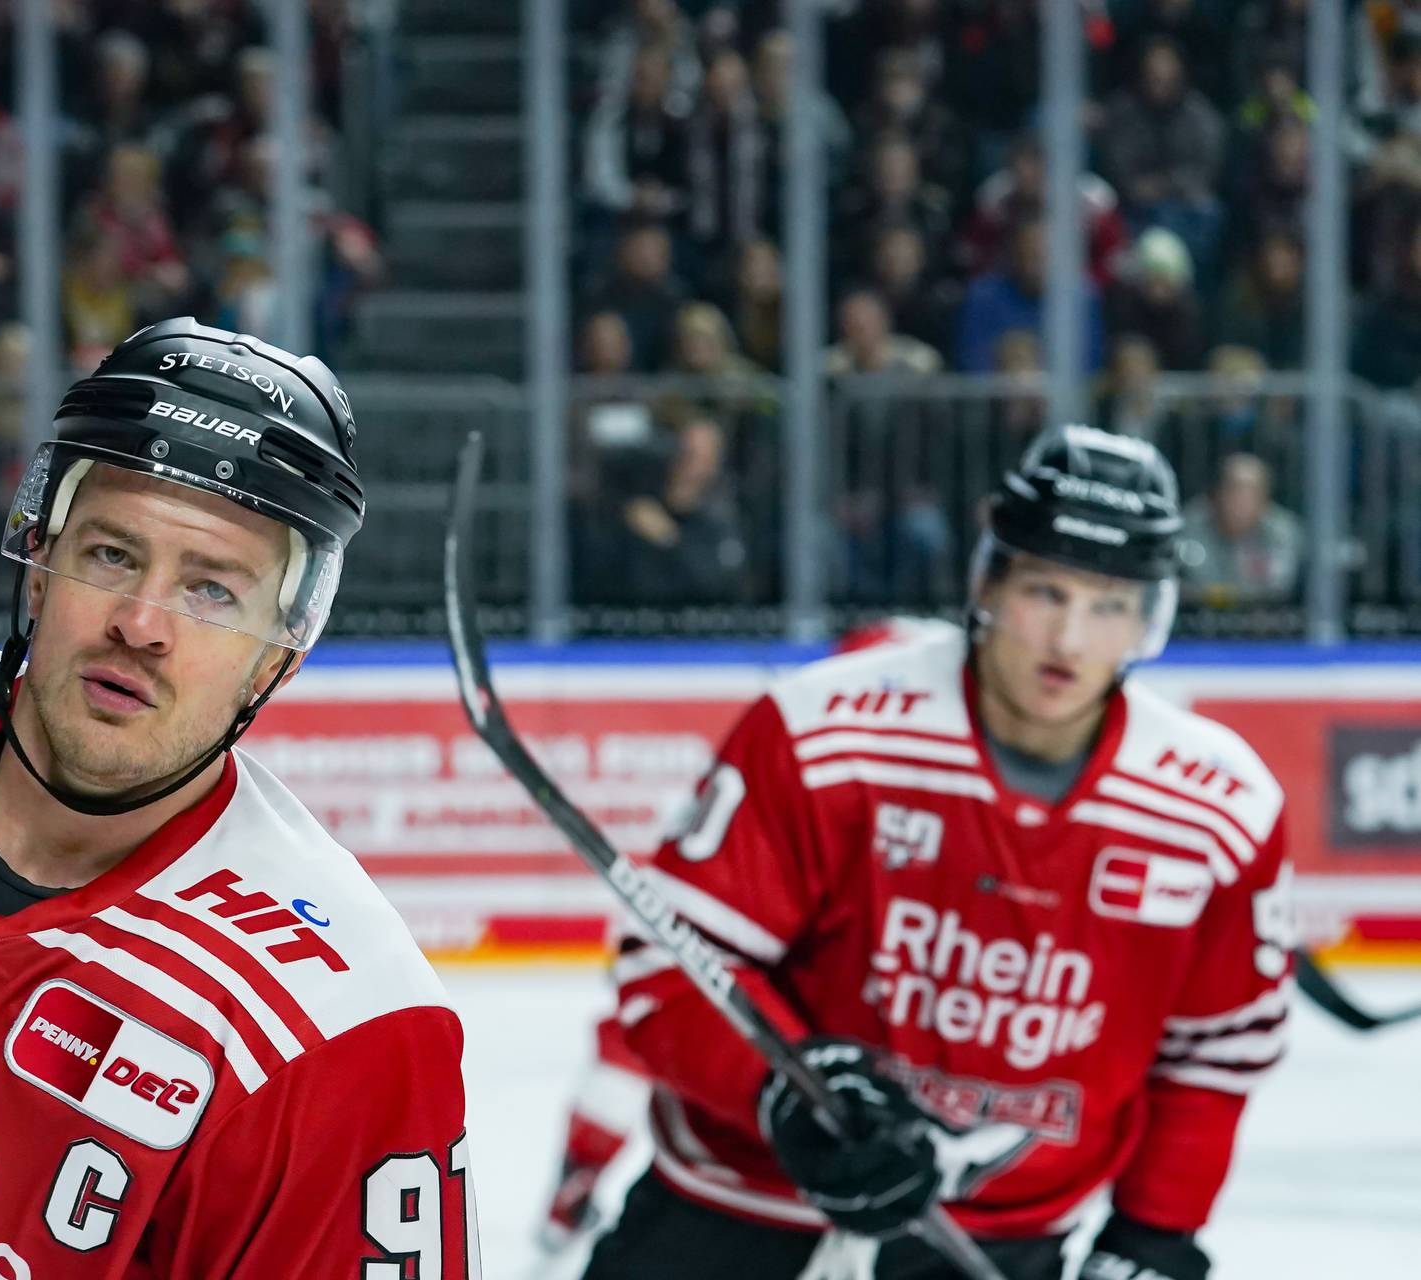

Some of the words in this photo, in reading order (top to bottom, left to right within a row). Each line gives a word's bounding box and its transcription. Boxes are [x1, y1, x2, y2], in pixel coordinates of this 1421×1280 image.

[158, 351, 295, 413] STETSON
[147, 400, 262, 447] BAUER
[825, 691, 933, 715] HIT
[1155, 747, 1252, 797] HIT
[174, 868, 351, 974] HIT
[881, 896, 1093, 1003] Rhein
[42, 1136, 133, 1254] C
